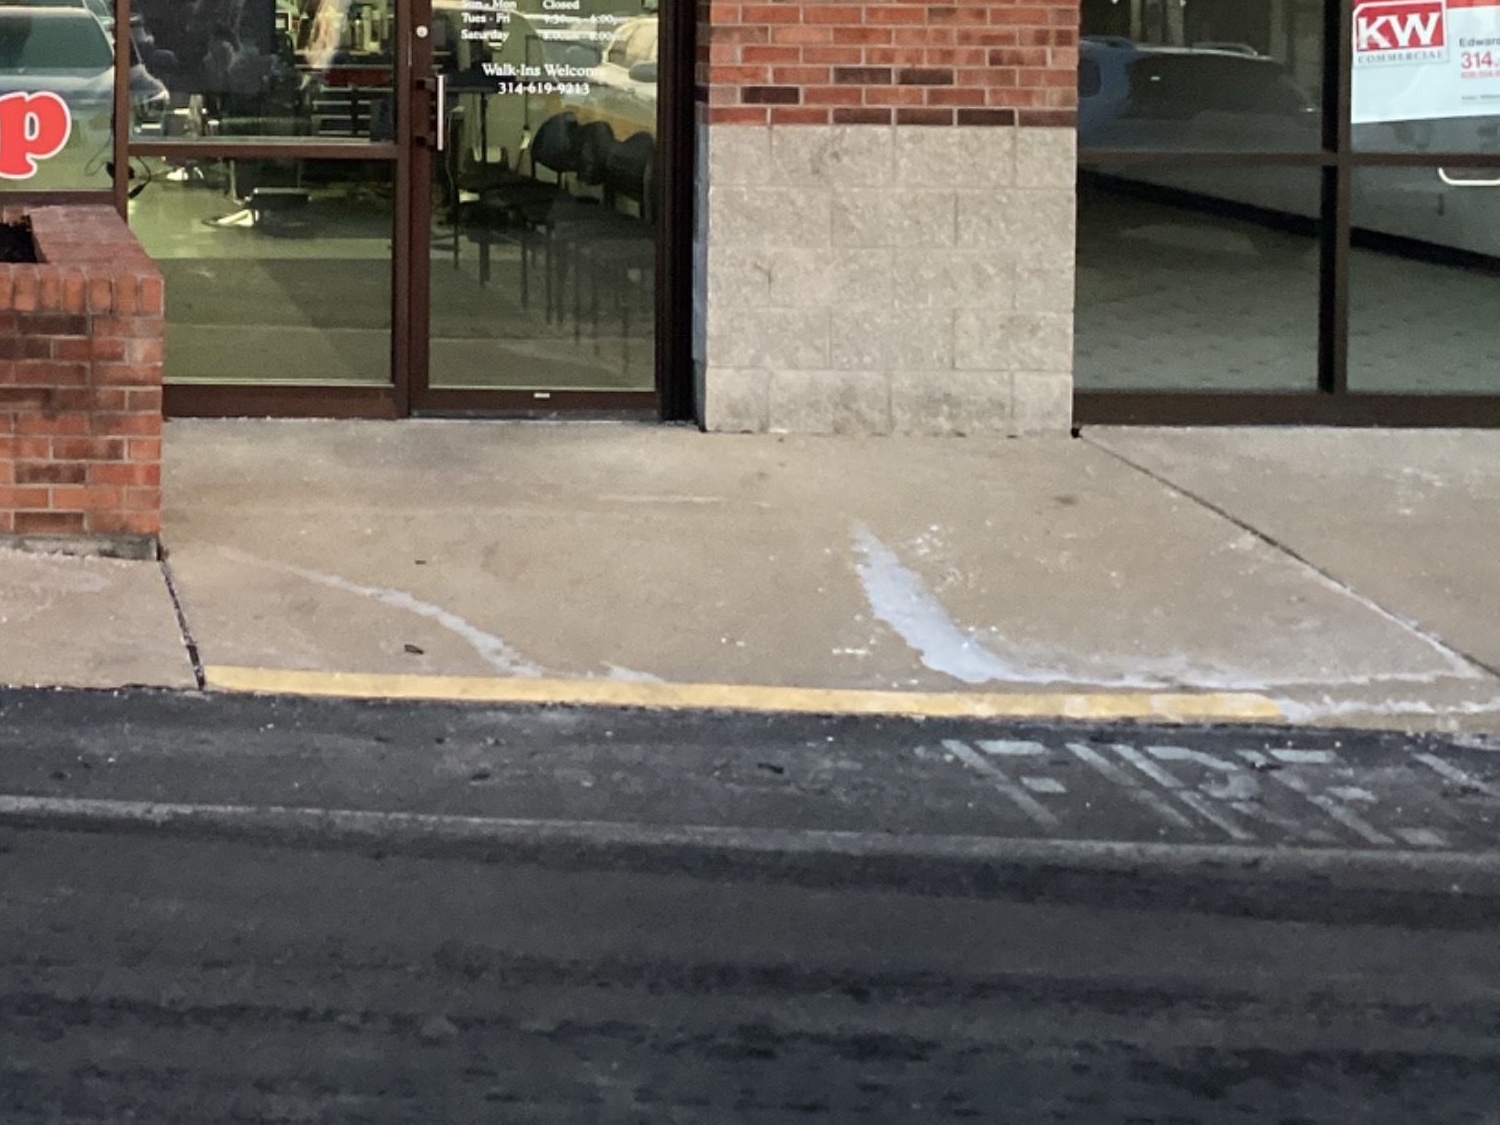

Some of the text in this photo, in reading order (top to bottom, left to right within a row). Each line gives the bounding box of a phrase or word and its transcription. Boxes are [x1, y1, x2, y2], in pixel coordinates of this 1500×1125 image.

[461, 12, 487, 24] Tues
[496, 12, 511, 24] Fri
[461, 28, 510, 43] Saturday
[1357, 11, 1441, 51] KW
[481, 63, 541, 77] Walk-Ins
